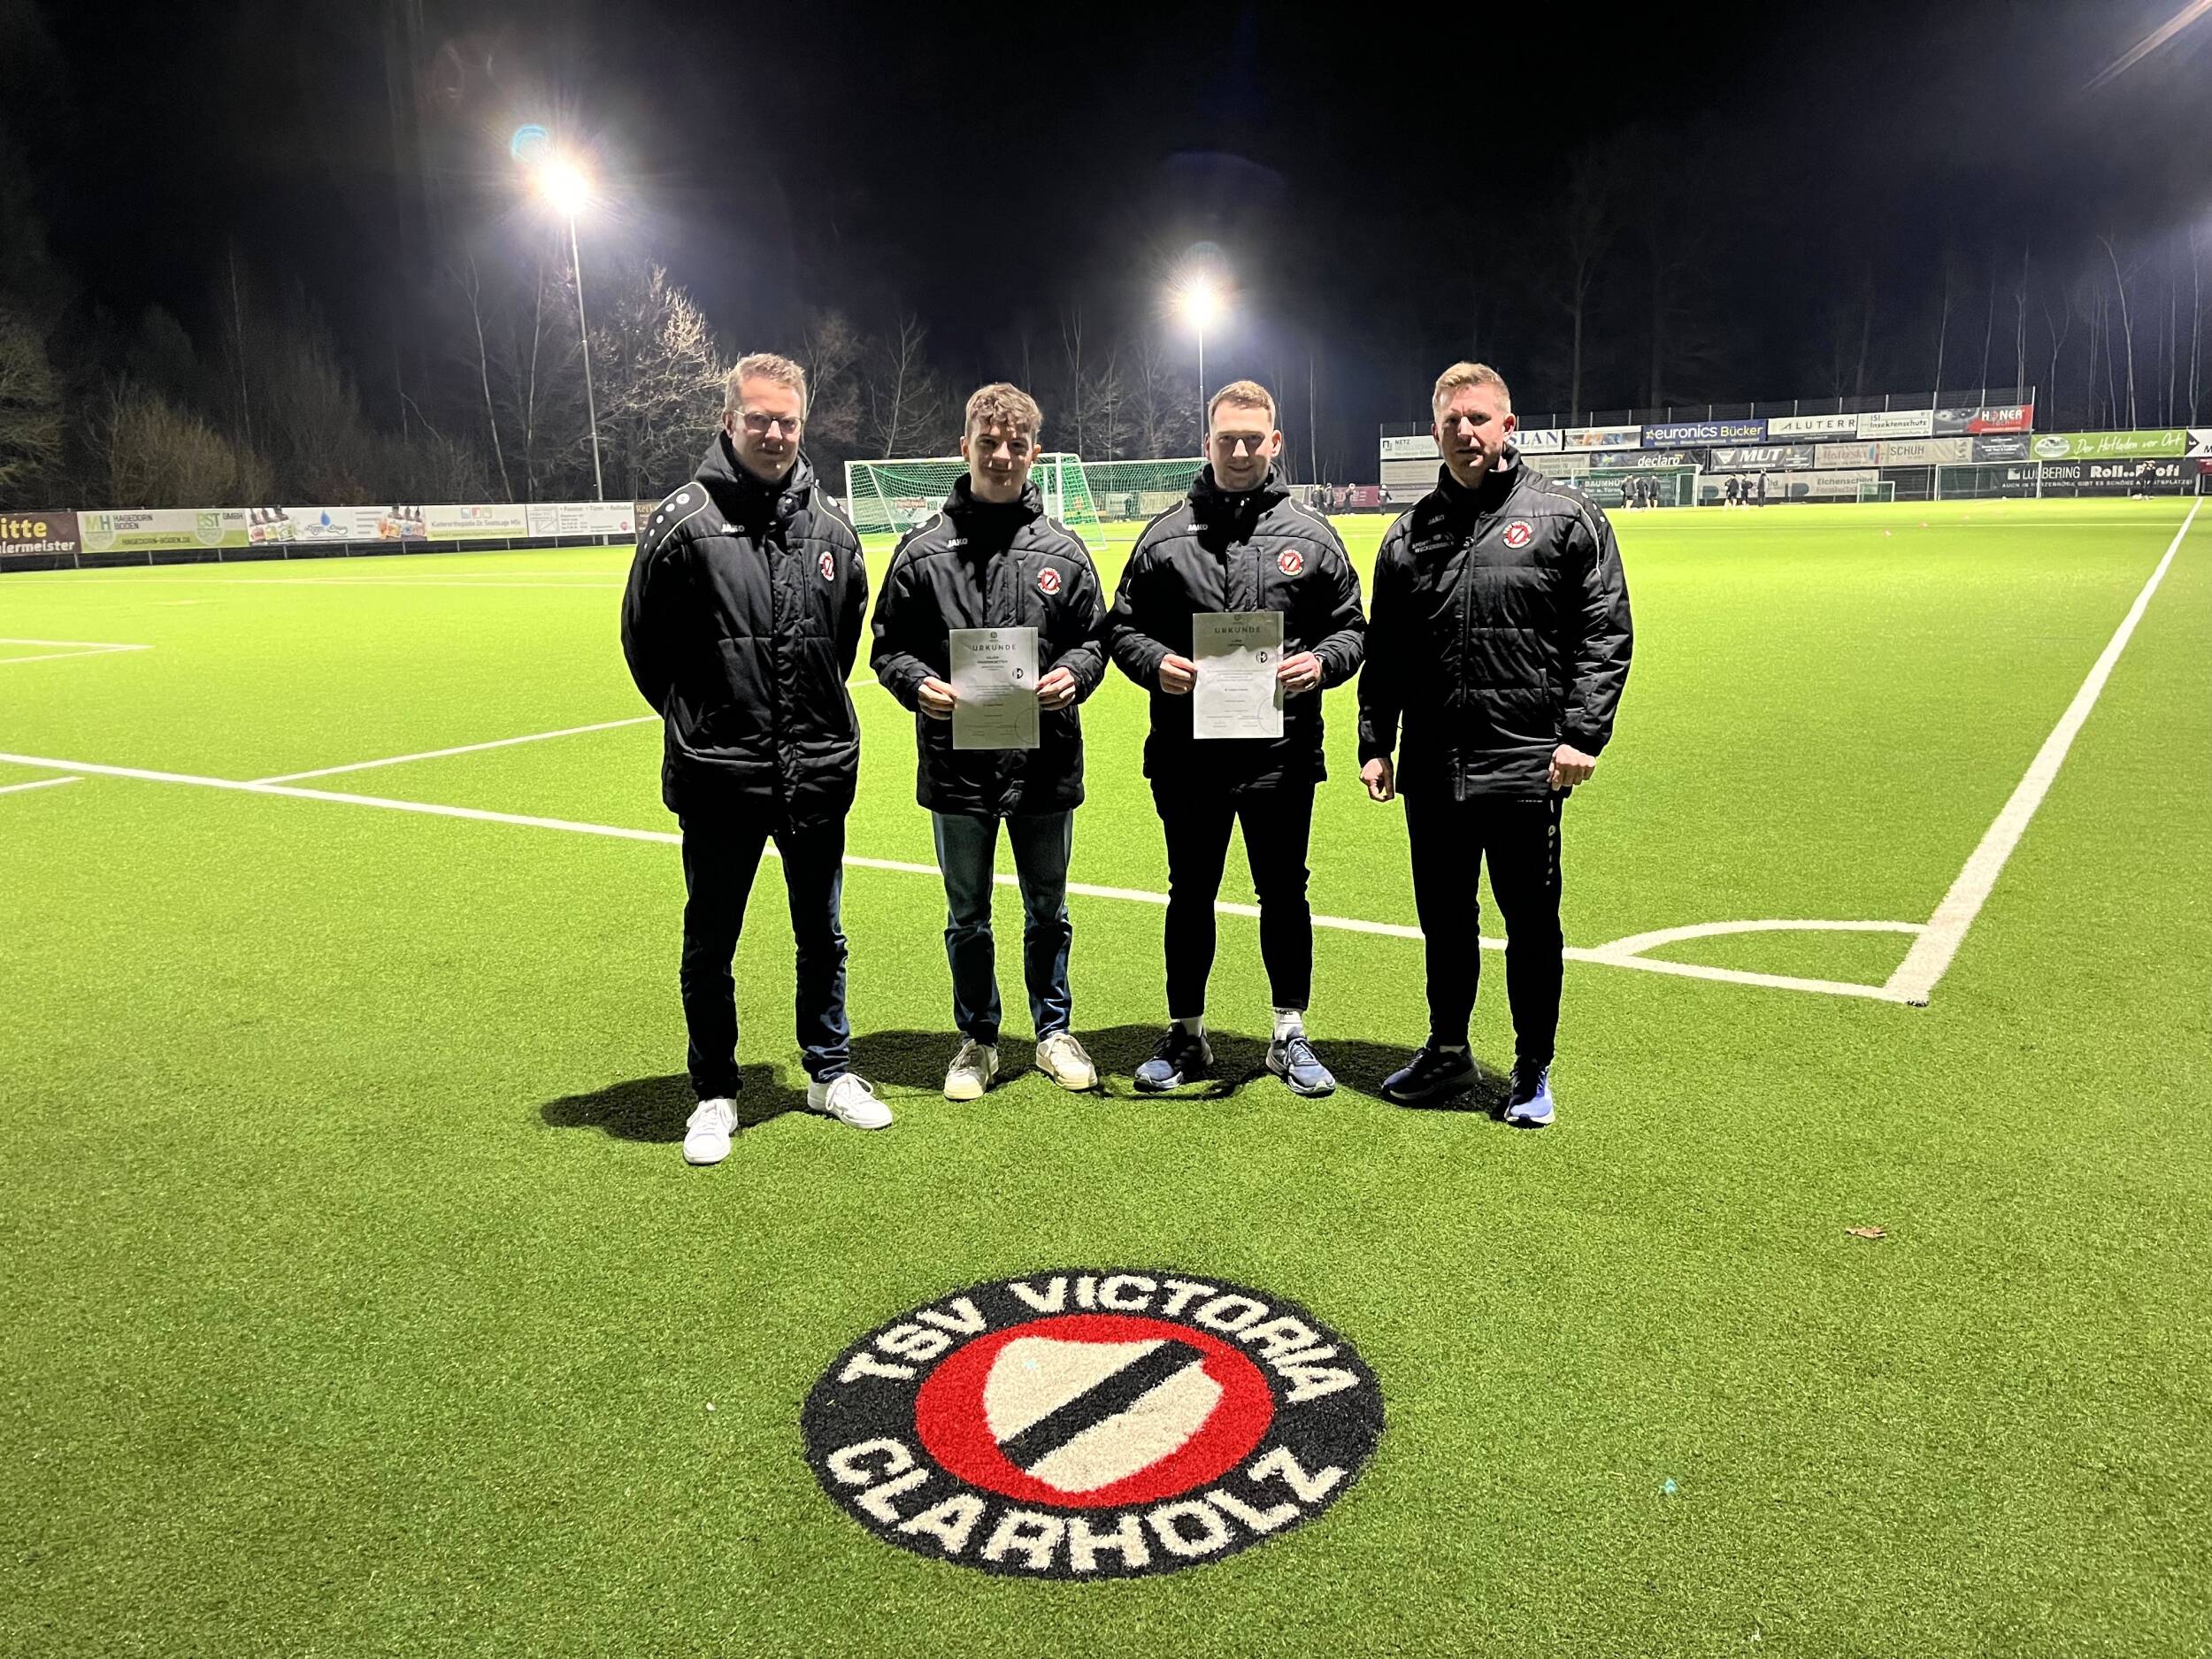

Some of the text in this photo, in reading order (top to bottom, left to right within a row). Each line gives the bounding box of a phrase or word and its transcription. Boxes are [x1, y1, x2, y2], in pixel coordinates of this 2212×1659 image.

[1870, 419, 1927, 428] Insektenschutz
[1655, 425, 1763, 440] euronics Bücker
[2162, 432, 2183, 447] Ort
[1740, 448, 1784, 462] MUT
[1890, 445, 1924, 456] SCHUH
[1637, 454, 1680, 466] declaro
[113, 514, 153, 524] HAGEDORN
[196, 513, 220, 527] BST
[0, 540, 75, 554] lermeister
[948, 537, 968, 548] JAKO
[837, 1273, 1363, 1405] TSV VICTORIA
[826, 1435, 1350, 1573] CLARHOLZ
